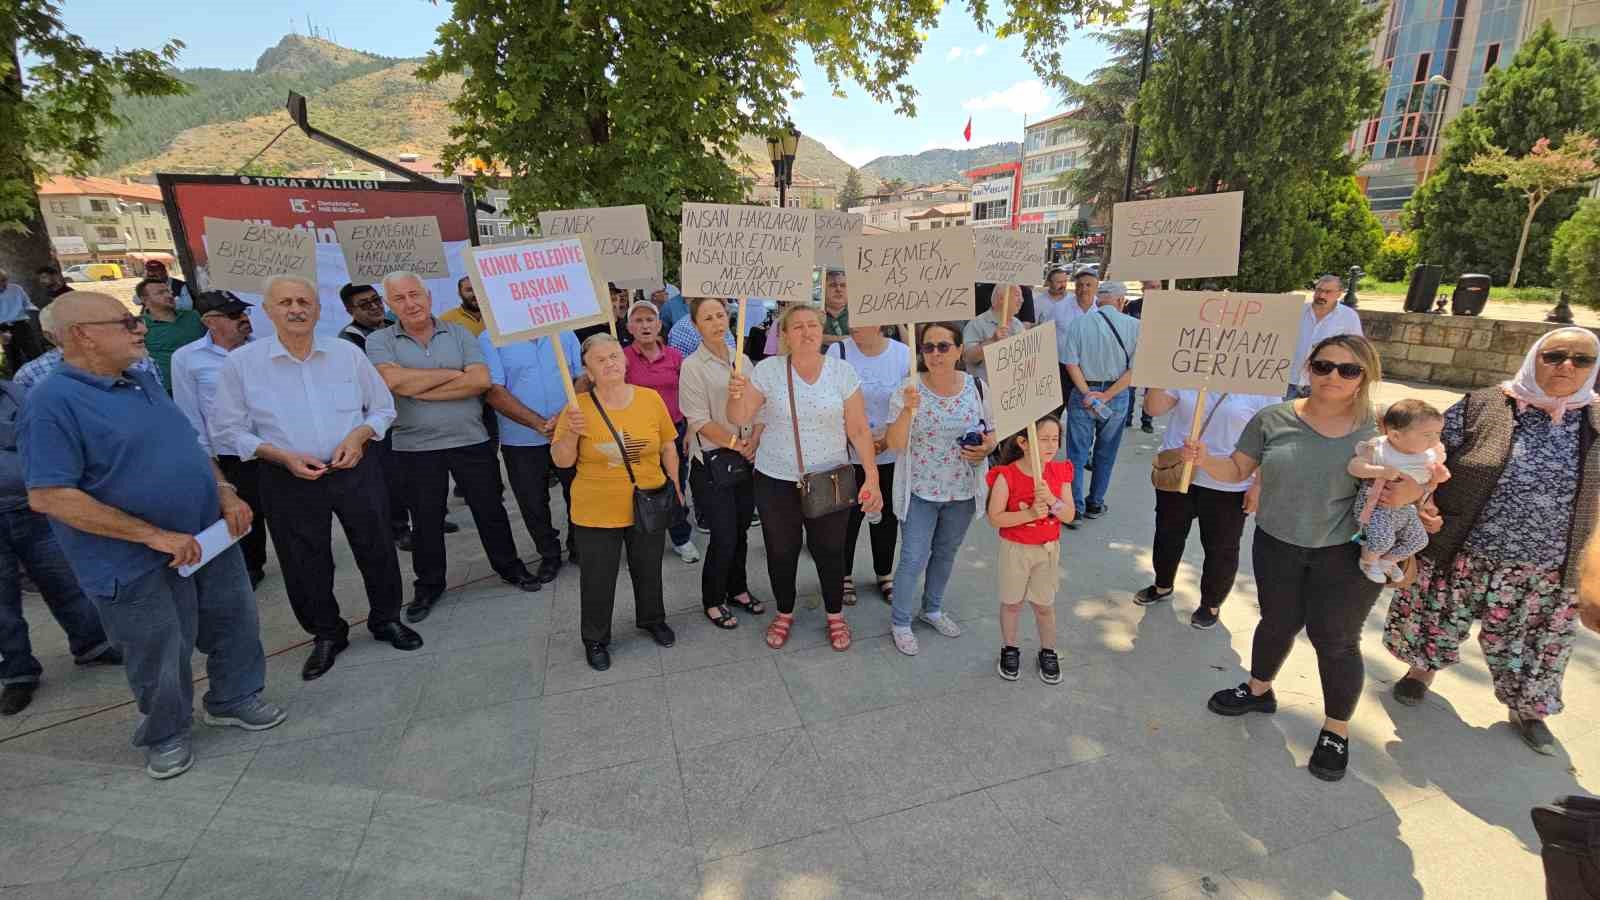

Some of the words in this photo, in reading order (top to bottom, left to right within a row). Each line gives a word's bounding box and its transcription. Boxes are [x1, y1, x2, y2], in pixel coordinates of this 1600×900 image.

[256, 178, 306, 188] TOKAT
[550, 215, 595, 235] EMEK
[748, 232, 802, 258] ETMEK
[478, 253, 522, 278] KINIK
[521, 243, 584, 271] BELEDİYE
[508, 274, 569, 302] BAŞKANI
[884, 266, 908, 287] AŞ
[527, 300, 570, 325] İSTİFA
[1199, 297, 1262, 325] CHP
[1179, 327, 1279, 355] MAMAMI
